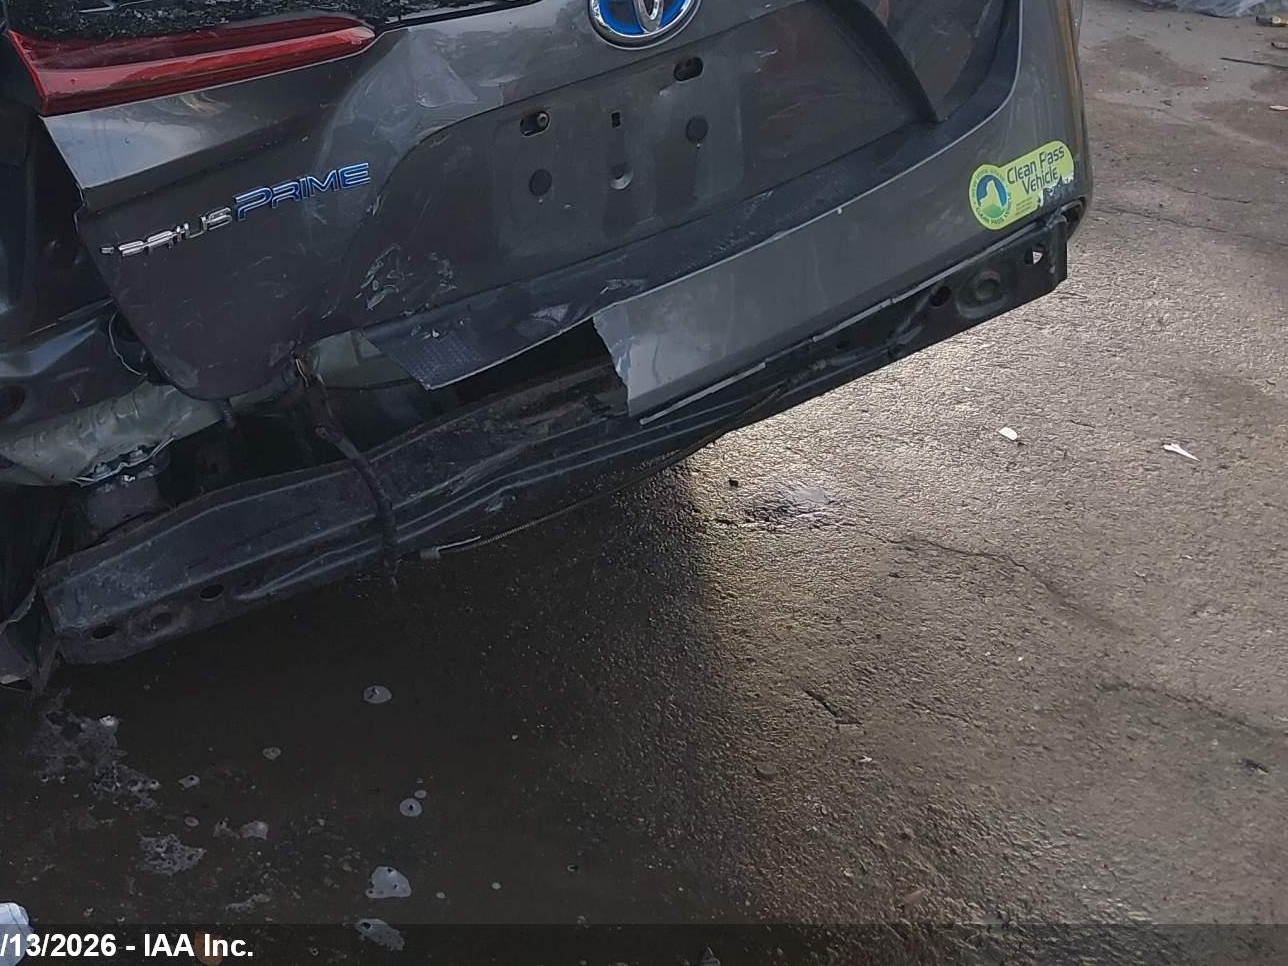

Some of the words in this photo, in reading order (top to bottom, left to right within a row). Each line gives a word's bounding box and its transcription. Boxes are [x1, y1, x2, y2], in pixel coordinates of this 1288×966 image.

[1007, 160, 1037, 185] Clean
[1039, 145, 1065, 168] Pass
[1022, 166, 1059, 195] Vehicle
[233, 162, 370, 221] PRIME
